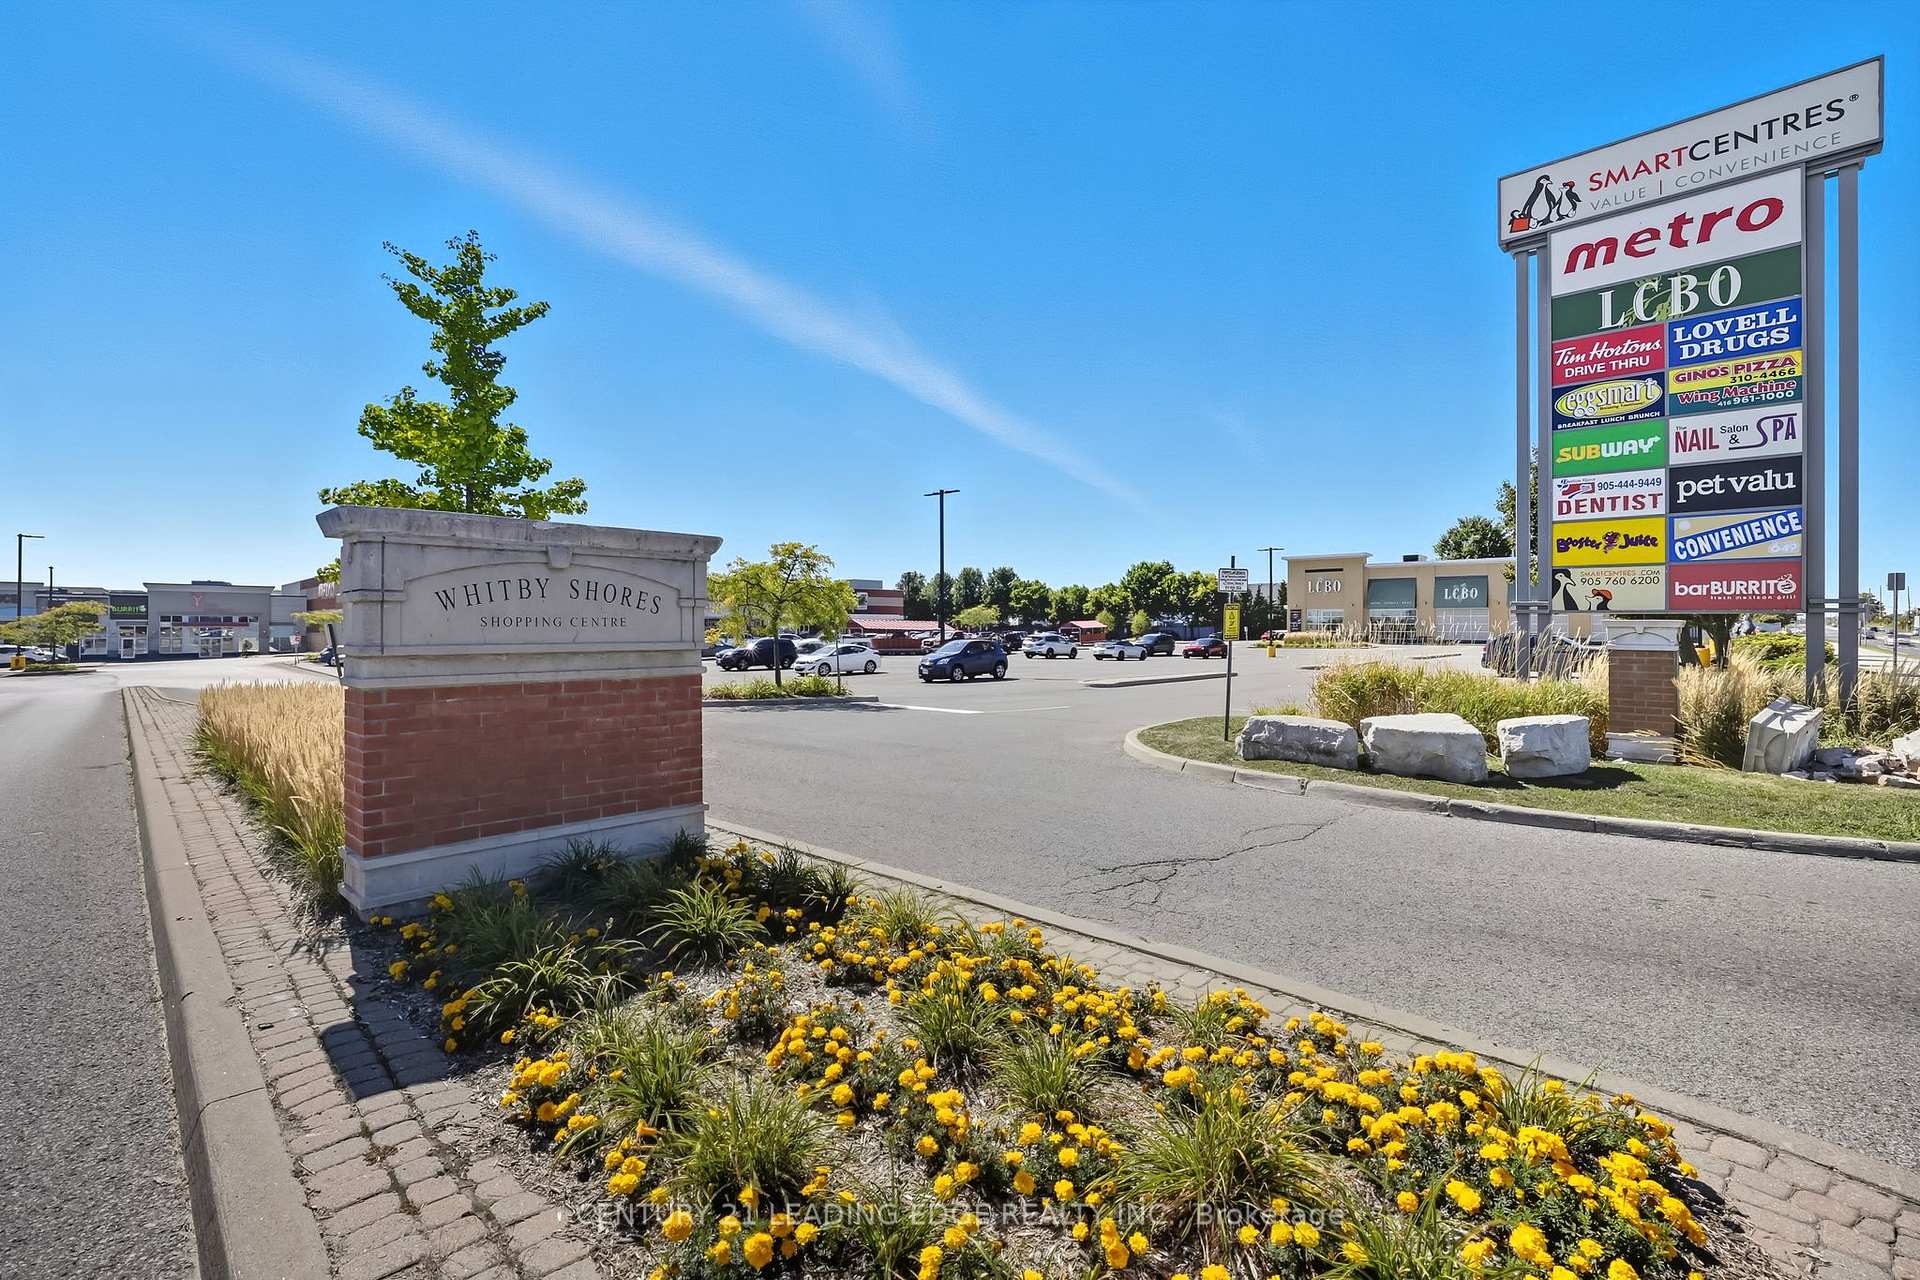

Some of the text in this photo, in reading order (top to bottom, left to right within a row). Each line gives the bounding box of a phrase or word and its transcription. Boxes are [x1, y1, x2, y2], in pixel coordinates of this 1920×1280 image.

[1591, 131, 1841, 211] VALUE CONVENIENCE
[1563, 197, 1785, 274] metro
[1598, 265, 1742, 331] LCBO
[1673, 307, 1797, 343] LOVELL
[1680, 326, 1790, 360] DRUGS
[1554, 346, 1586, 367] Tim
[1565, 355, 1650, 378] DRIVE THRU
[1734, 356, 1797, 375] PIZZA
[1730, 367, 1796, 384] 310-4466
[1566, 378, 1657, 418] eggsmart
[1678, 380, 1797, 405] Wing Machine
[1732, 390, 1794, 405] 961-1000
[1557, 411, 1660, 429] BREAKFAST LUNCH BRUNCH
[1675, 413, 1798, 454] NAIL Salon & SPA
[1556, 436, 1661, 463] SUBWAY
[1597, 477, 1662, 491] 905-444-9449
[1676, 469, 1797, 503] pet valu
[1557, 493, 1663, 516] DENTIST
[1556, 534, 1659, 553] Booster Juice
[1674, 511, 1802, 561] CONVENIENCE
[1308, 579, 1341, 593] LCBO
[1580, 576, 1660, 585] 905 760 6200
[434, 577, 662, 615] WHITBY SHORES
[1444, 587, 1479, 600] LCBO
[480, 616, 627, 628] SHOPPING CENTRE
